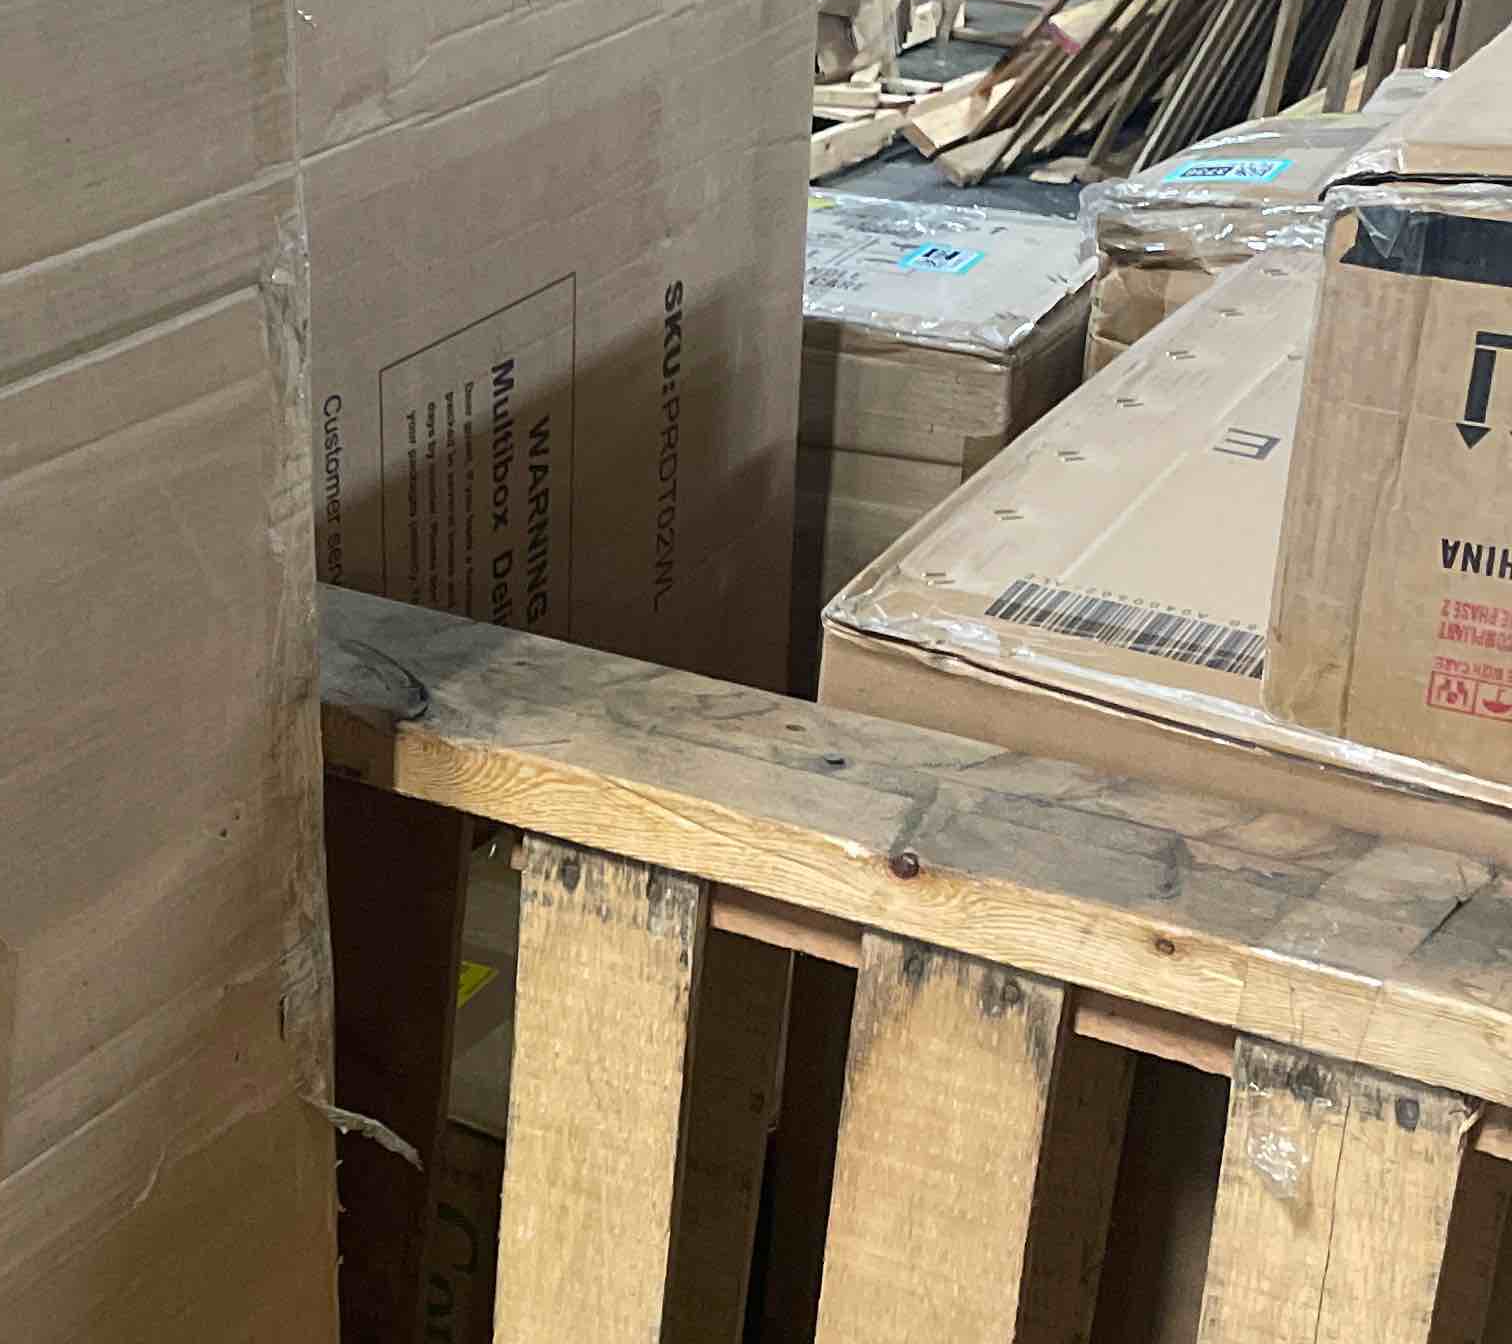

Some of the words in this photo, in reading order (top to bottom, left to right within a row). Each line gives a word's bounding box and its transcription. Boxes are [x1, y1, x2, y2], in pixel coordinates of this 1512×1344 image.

[323, 393, 343, 525] Customer
[491, 358, 515, 532] Multibox
[526, 415, 551, 624] WARNING
